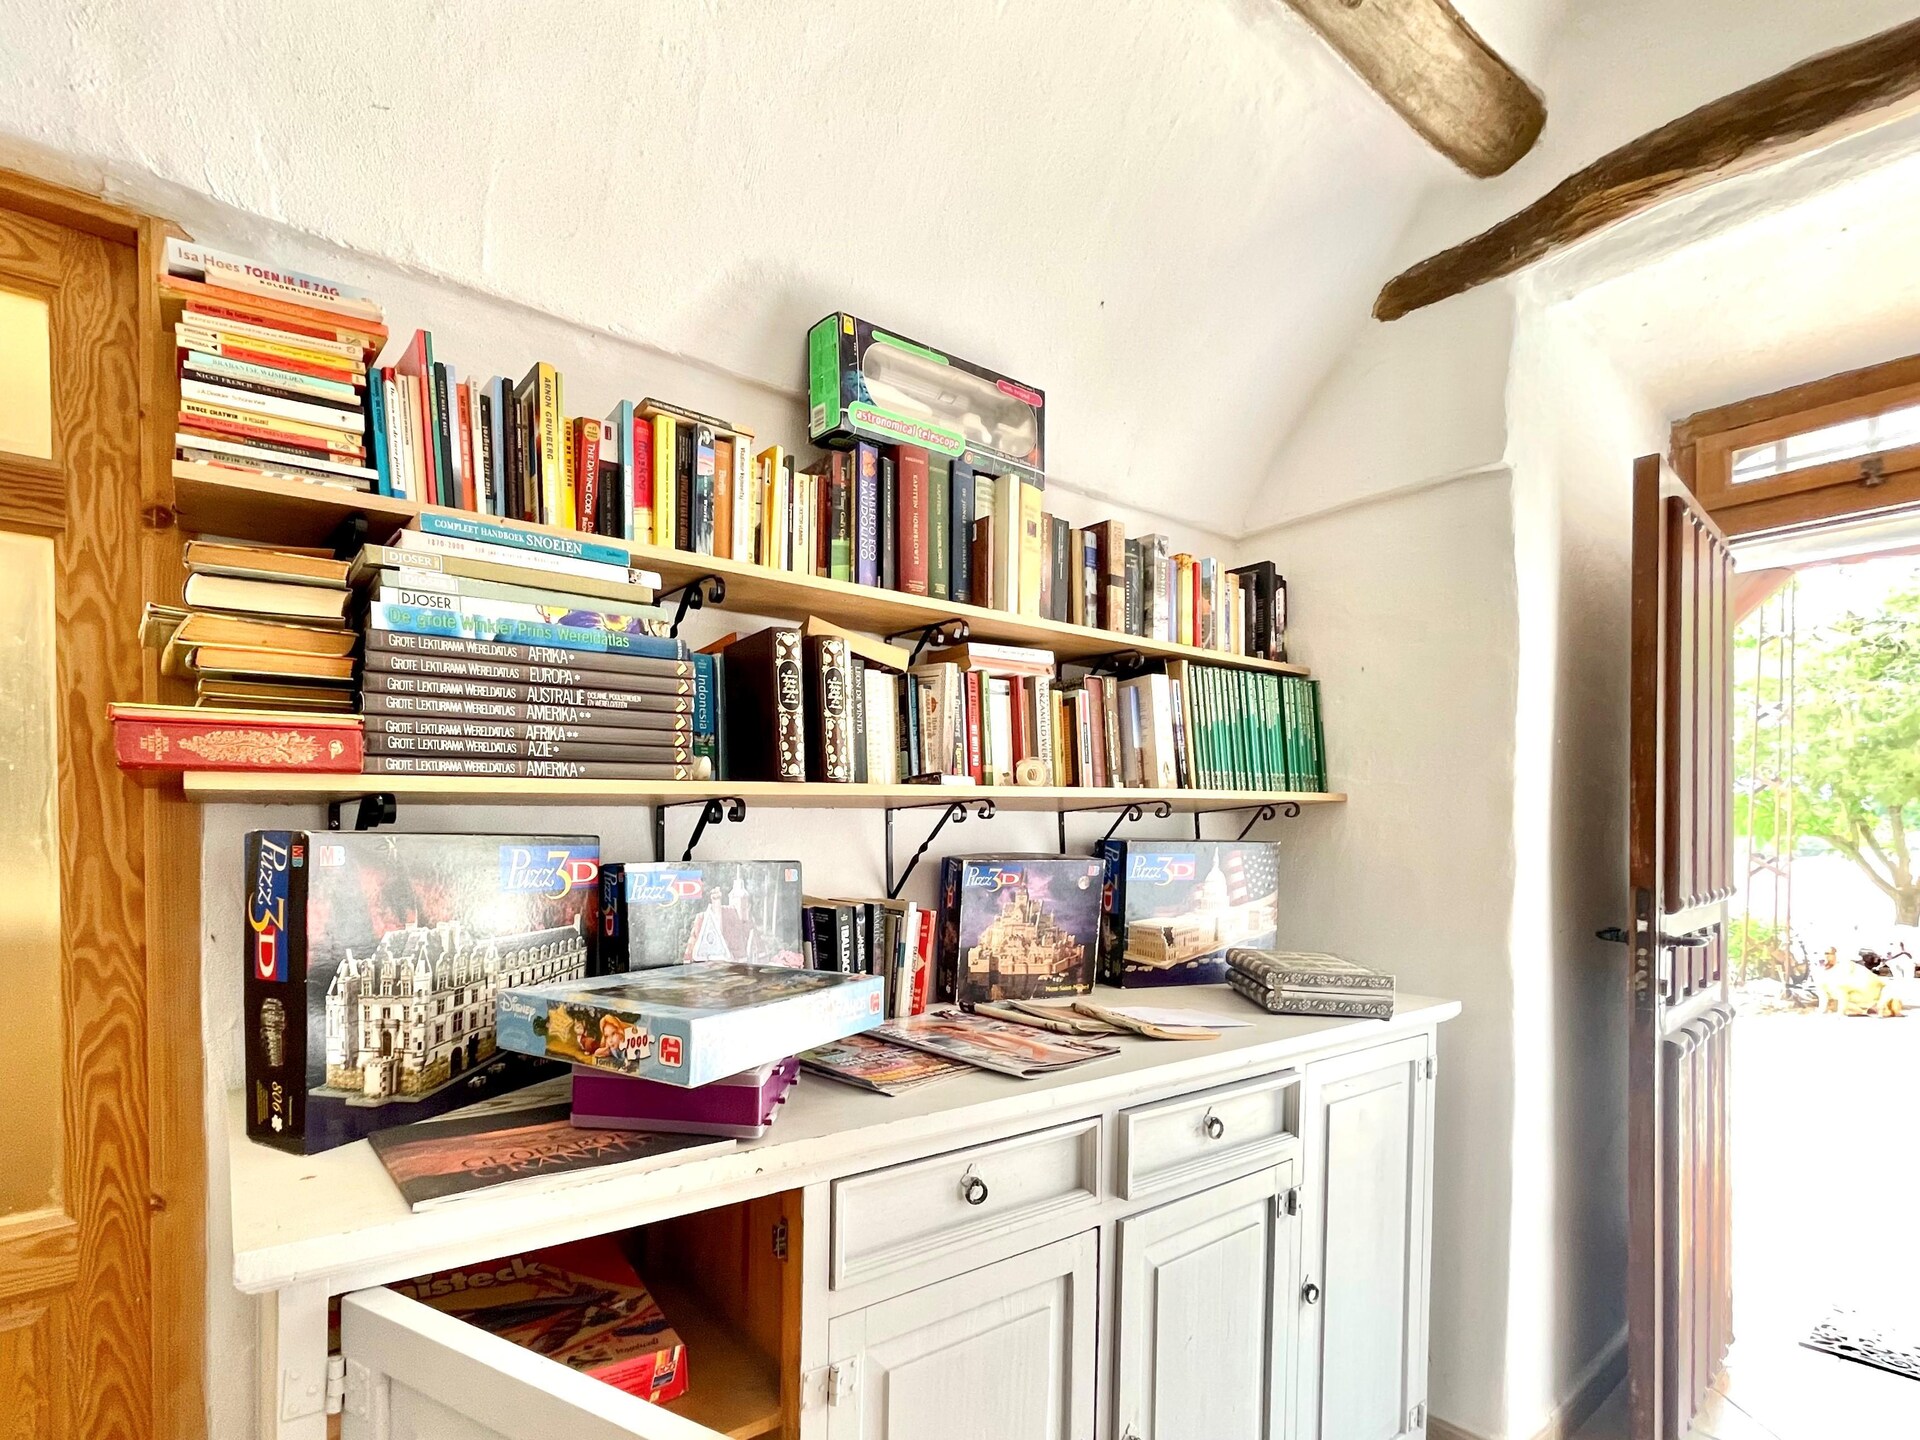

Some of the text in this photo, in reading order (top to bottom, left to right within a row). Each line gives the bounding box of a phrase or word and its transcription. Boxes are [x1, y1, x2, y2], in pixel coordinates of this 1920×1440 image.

[178, 247, 199, 262] Isa
[203, 254, 240, 273] Hoes
[244, 264, 280, 282] TOEN
[283, 275, 295, 286] IK
[313, 283, 340, 297] ZAG
[196, 371, 219, 382] NICCI
[222, 378, 253, 389] FRENCH
[187, 404, 239, 419] BRUCE CHATWIN
[544, 377, 553, 460] ARNON GRUNBERG
[856, 408, 960, 451] astronomical telescope
[585, 460, 594, 472] DA
[585, 472, 594, 492] VINCI
[584, 493, 593, 515] CODE
[868, 482, 876, 536] UMBERTO
[435, 518, 582, 555] COMPLEET HANDBOEK SNOEIEN
[389, 553, 432, 566] DJOSER
[402, 592, 451, 609] DJOSER
[389, 608, 630, 648] De grote Winkler Prins Wereldatlas
[388, 634, 568, 664] GROTE LEKTURAMA WERELDATLAS AFRIKA
[391, 656, 573, 685] GROTE LEKTURAMA WERELDATLAS EUROPA
[387, 677, 414, 691] GROTE
[417, 680, 463, 695] LEKTURAMA
[464, 683, 516, 699] WERELDATLAS
[856, 690, 862, 701] DE
[386, 695, 578, 722] GROTE LEKTURAMA WERELDATLAS AMERIKA
[697, 674, 710, 729] Indonesia
[1038, 682, 1047, 737] VERZAMELD
[385, 720, 566, 741] GROTE LEKTURAMA WERELDATLAS AFRIKA
[388, 736, 517, 754] GROTE LEKTURAMA WERELDATLAS
[385, 757, 578, 777] GROTE LEKTURAMA WERELDATLAS AMERIKA
[291, 844, 304, 868] MB
[320, 845, 346, 867] MB
[505, 849, 598, 901] Puzz 3D
[965, 866, 1020, 892] Puzz 3D
[1130, 855, 1194, 886] Puzz 3D
[630, 872, 701, 907] Puzz 3D
[249, 834, 288, 978] Puzz 3D
[626, 1035, 648, 1049] 1000
[271, 1081, 283, 1113] 806
